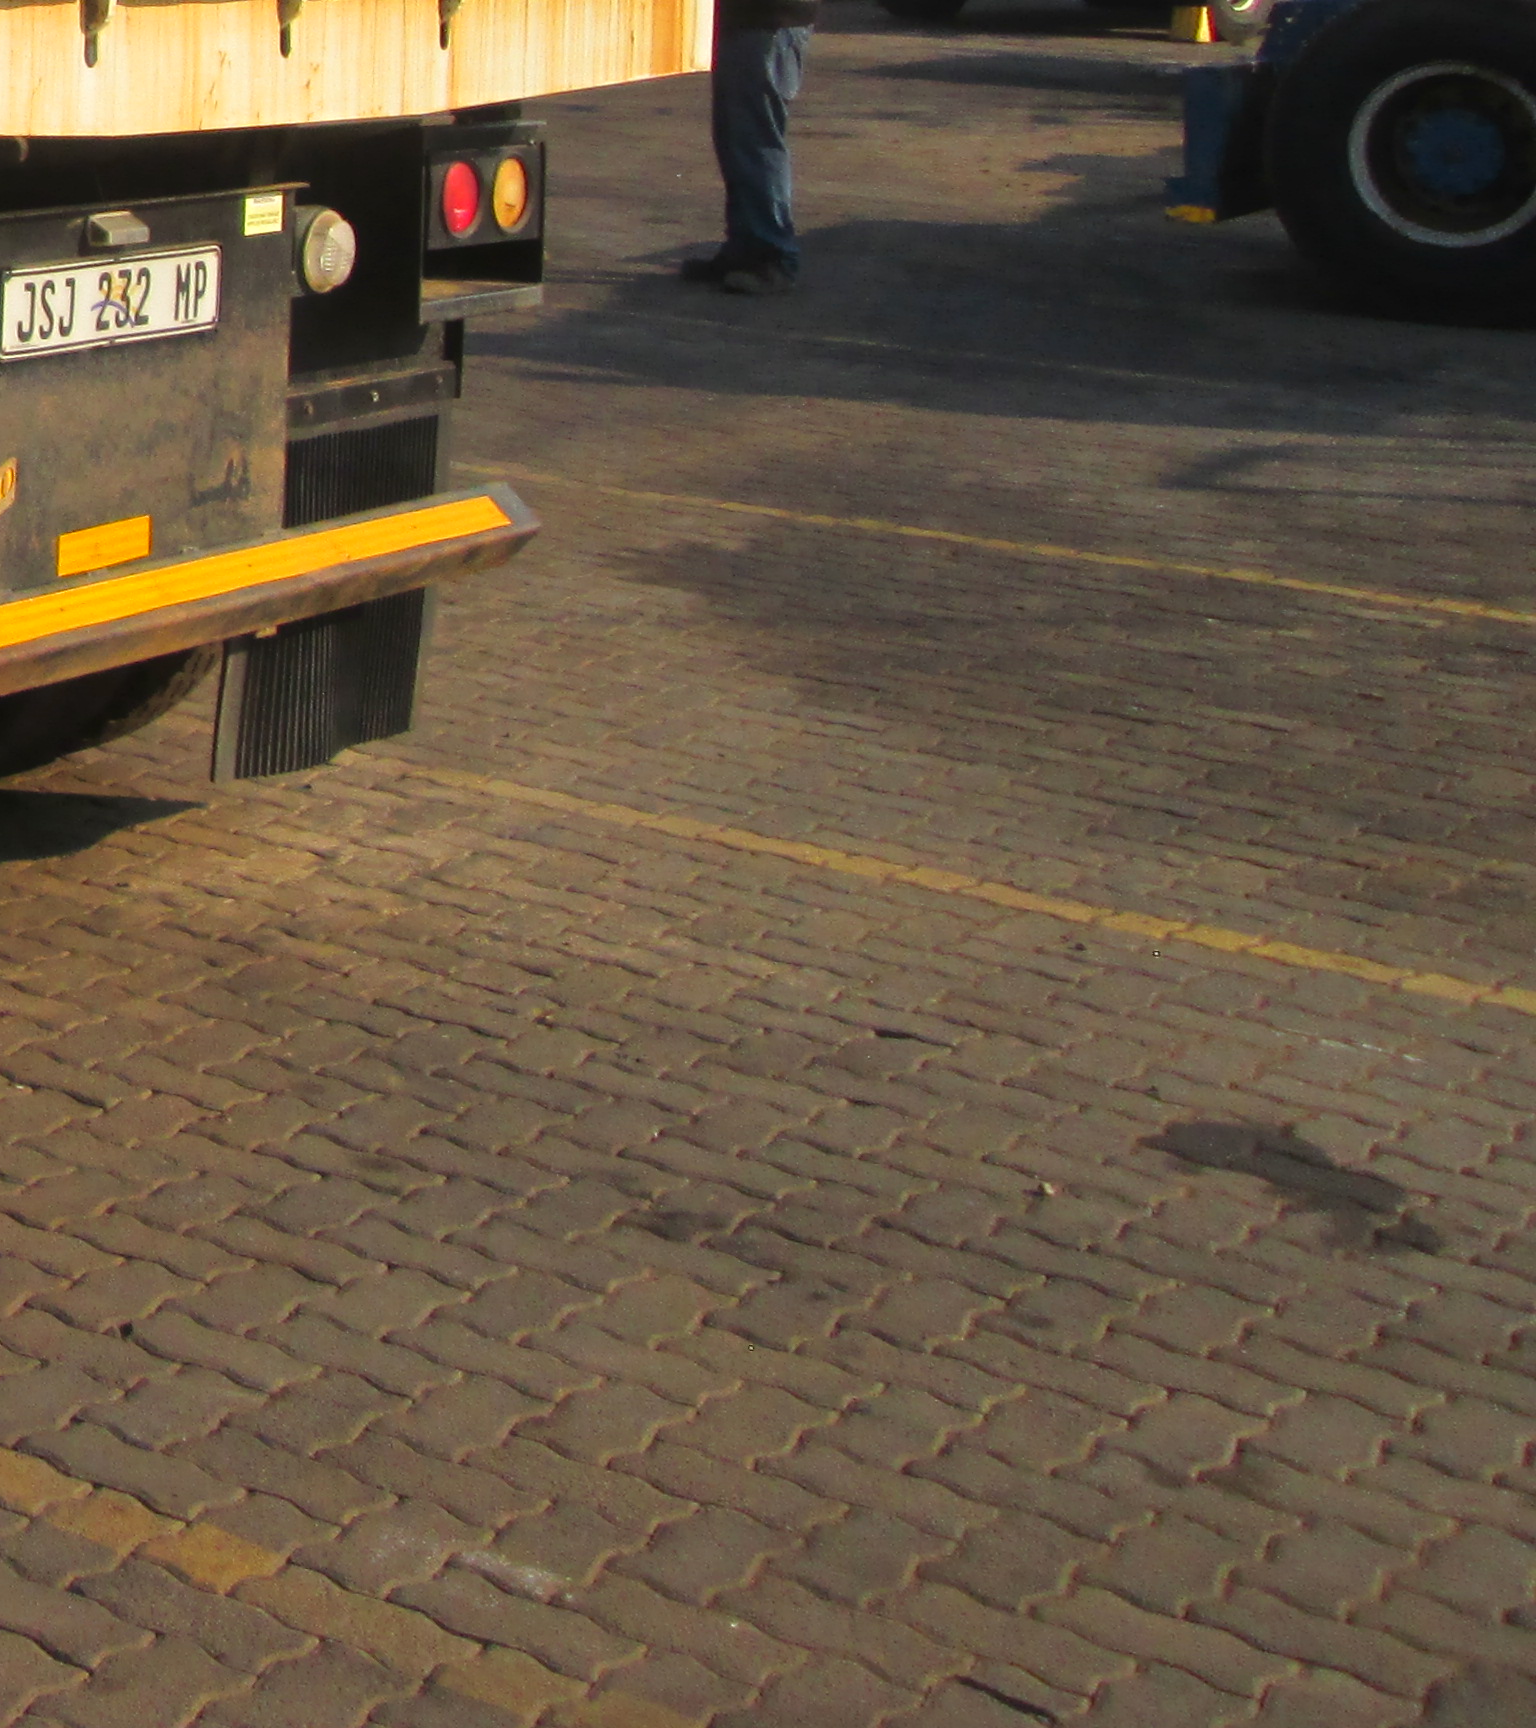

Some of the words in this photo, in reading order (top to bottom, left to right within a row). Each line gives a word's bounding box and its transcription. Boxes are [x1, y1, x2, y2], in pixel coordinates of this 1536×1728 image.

[16, 277, 76, 343] JSJ
[95, 267, 151, 331] 232
[174, 260, 208, 322] MP
